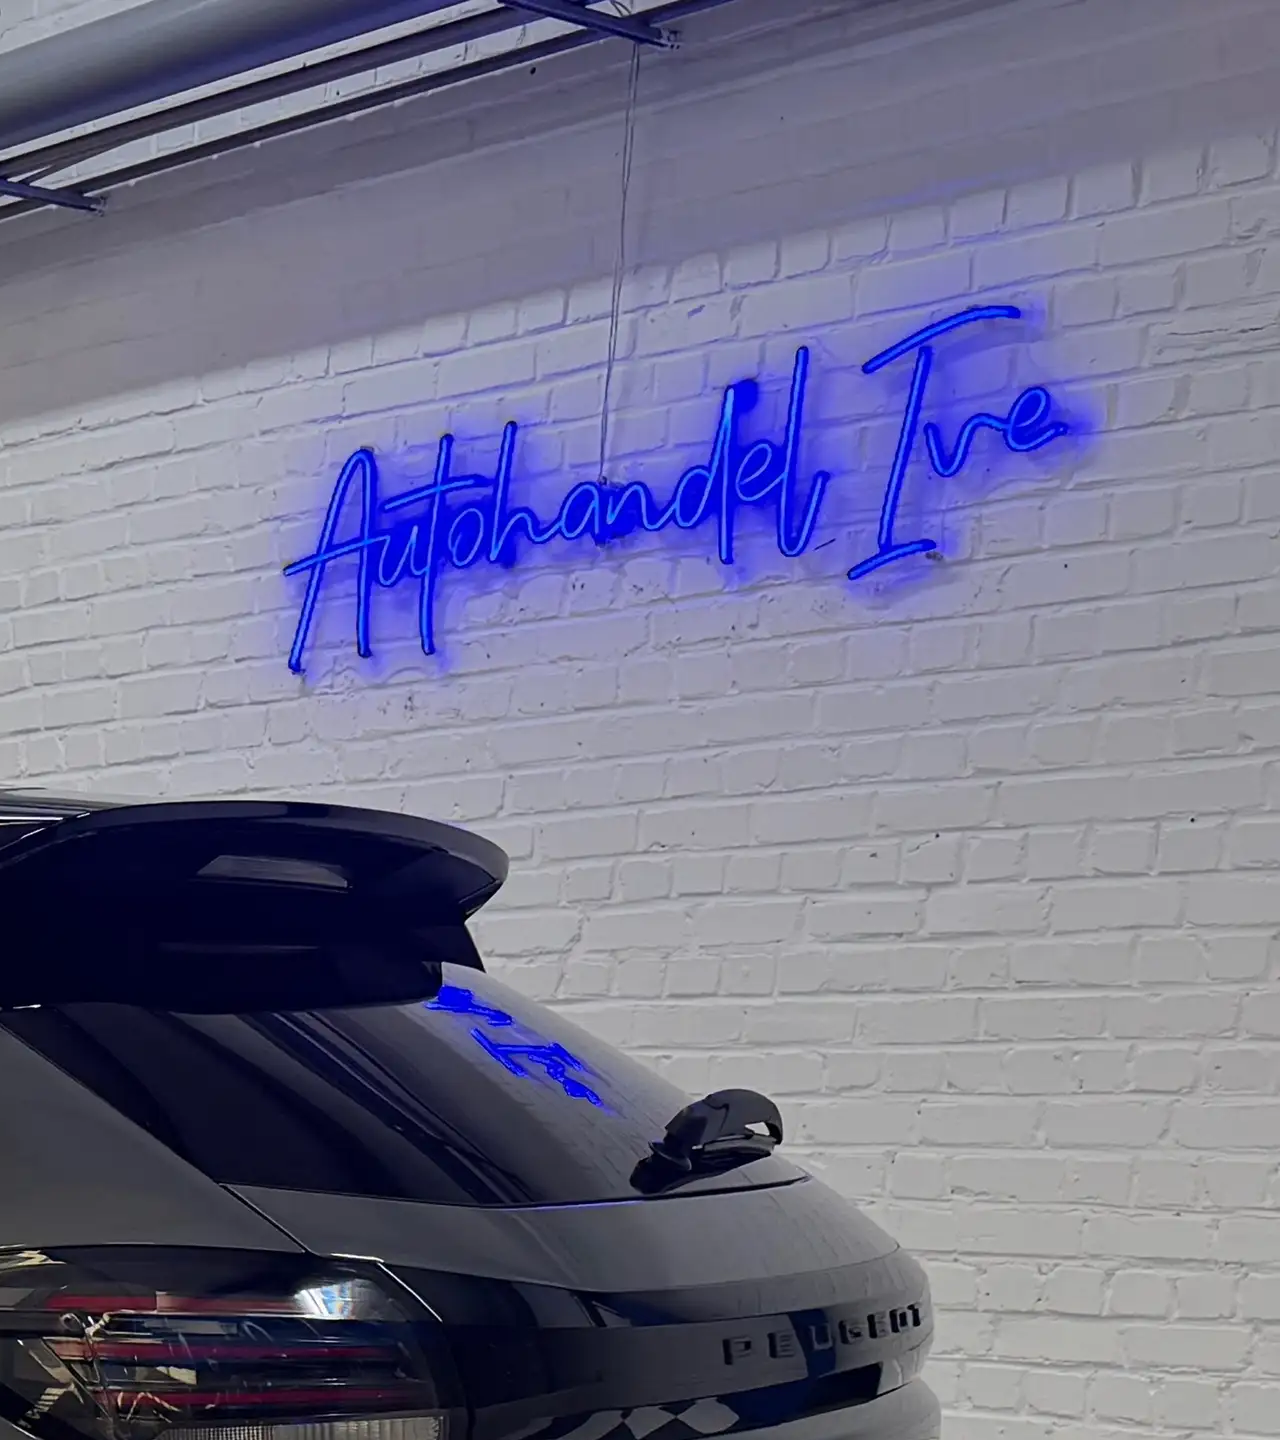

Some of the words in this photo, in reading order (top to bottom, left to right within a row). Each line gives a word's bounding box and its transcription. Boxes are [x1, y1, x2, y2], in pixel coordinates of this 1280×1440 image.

[284, 345, 831, 673] Autohandel
[846, 305, 1066, 581] Ive
[722, 1303, 922, 1366] PEUGEOT
